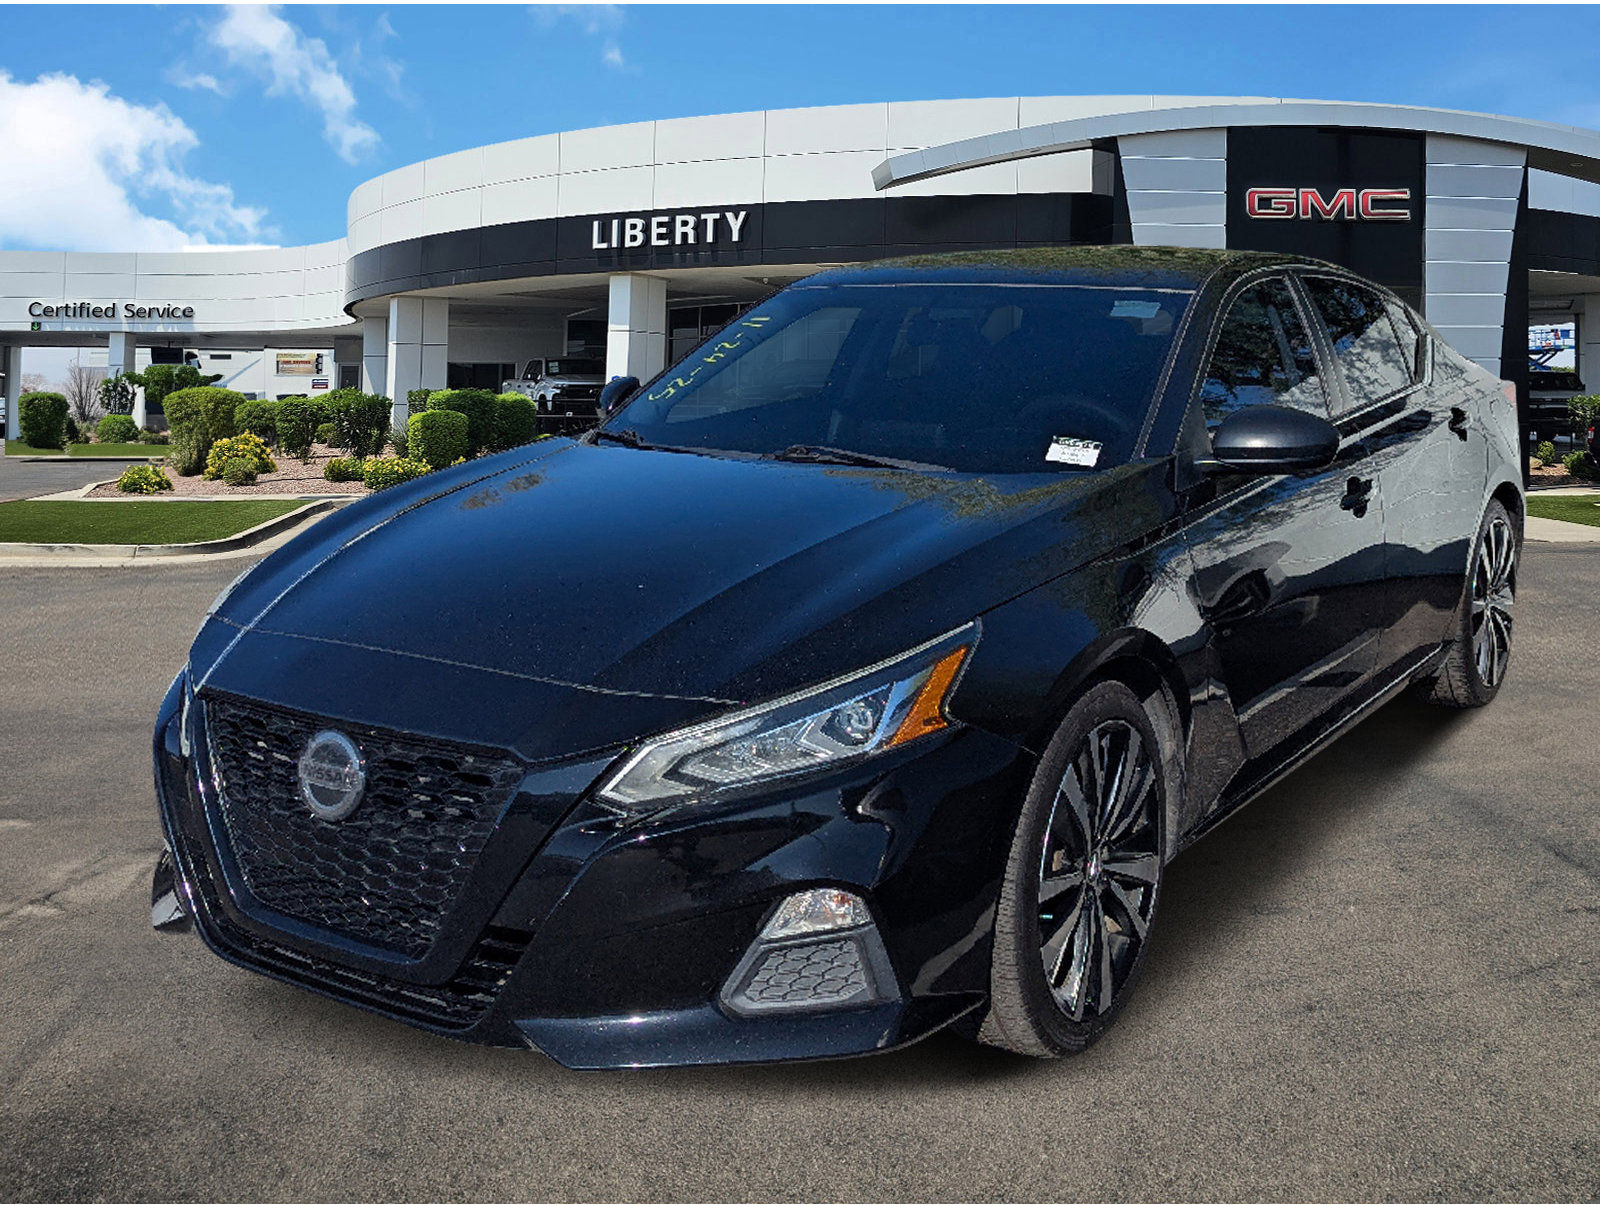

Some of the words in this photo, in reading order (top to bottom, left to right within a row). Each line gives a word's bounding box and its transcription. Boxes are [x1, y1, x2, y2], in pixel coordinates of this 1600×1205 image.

[1245, 187, 1411, 221] GMC
[592, 210, 748, 250] LIBERTY
[28, 301, 116, 319] Certified
[124, 302, 194, 319] Service
